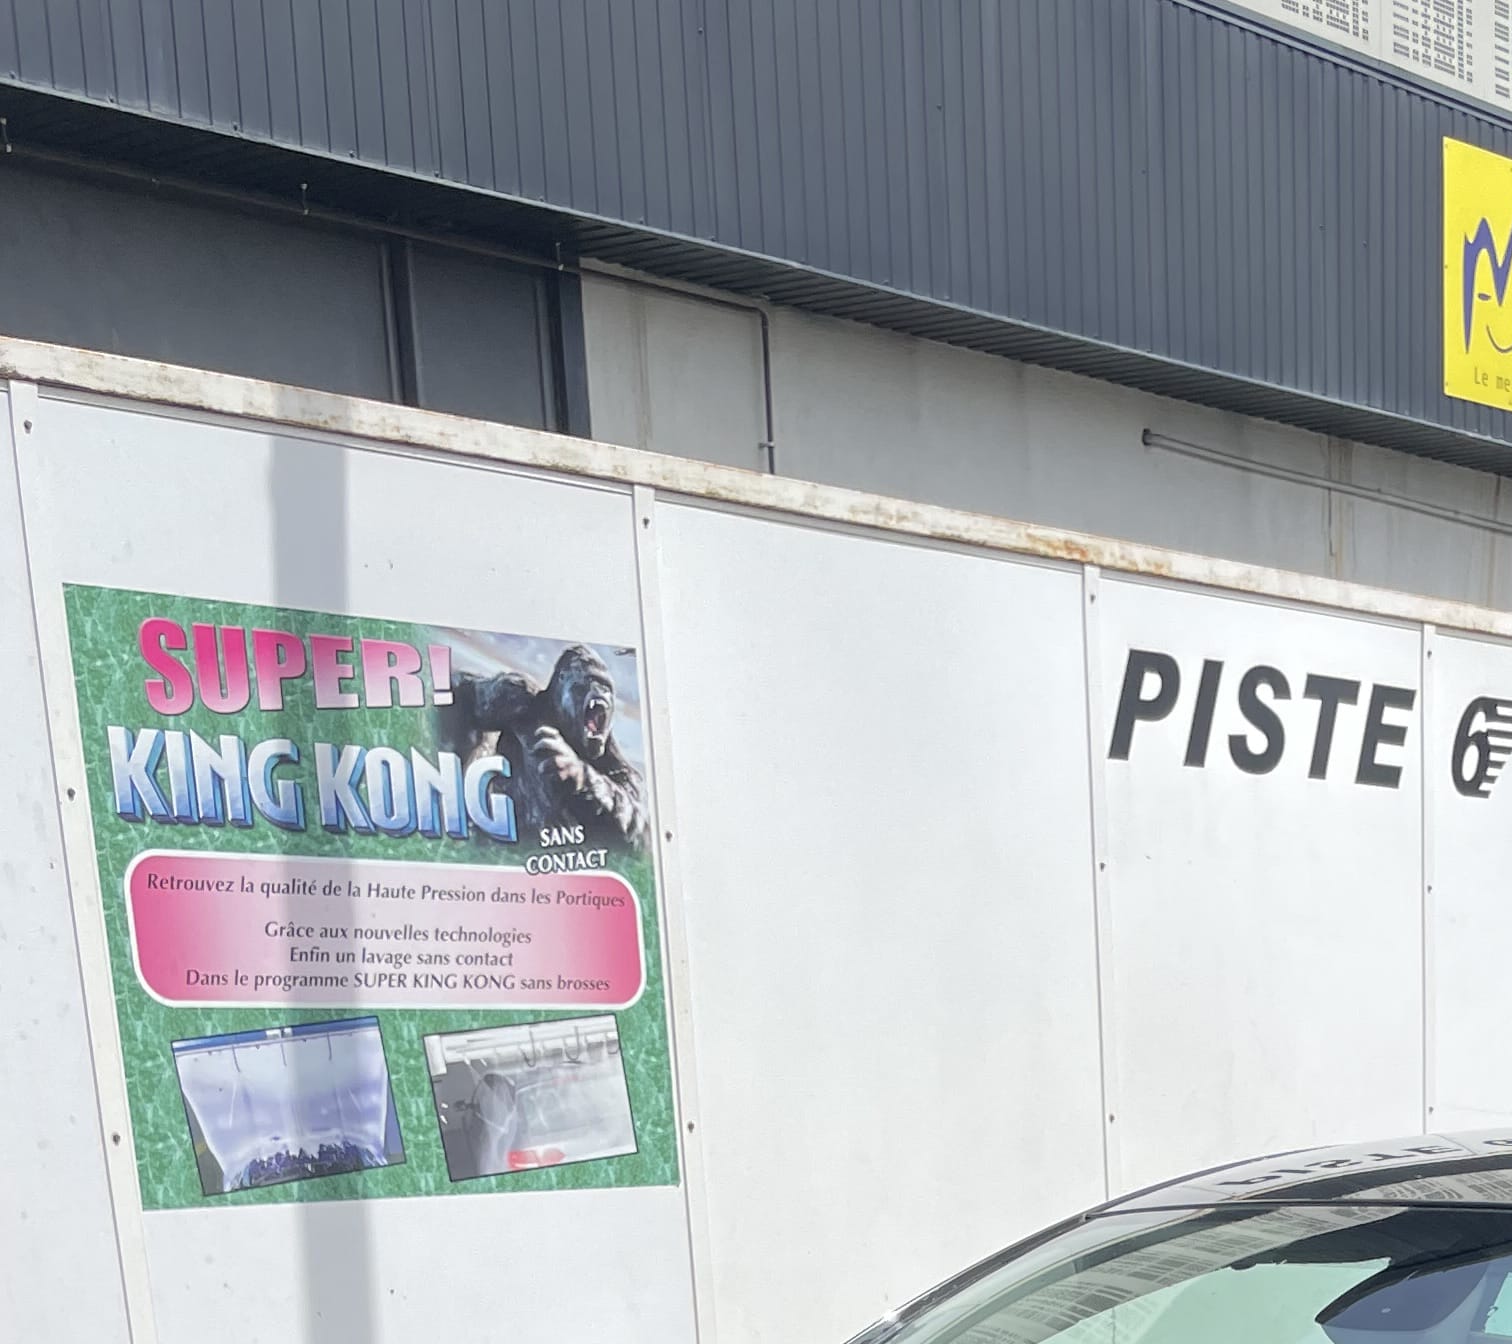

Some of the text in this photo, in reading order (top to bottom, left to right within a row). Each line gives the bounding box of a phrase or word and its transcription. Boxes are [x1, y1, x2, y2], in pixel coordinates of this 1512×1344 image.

[1474, 367, 1488, 385] Le
[138, 617, 454, 716] SUPER!
[1107, 649, 1417, 789] PISTE
[107, 724, 518, 843] KING KONG
[539, 824, 585, 848] SANS
[525, 848, 609, 875] CONTACT
[147, 873, 626, 910] Retrouvez la qualité de la Haute Pression dans les Portiques
[264, 921, 532, 948] Grâce aux nouvelles technologies
[290, 946, 514, 969] Enfin un lavage sans contact
[186, 969, 611, 991] Dans le programme SUPER KING KONG sans brosses
